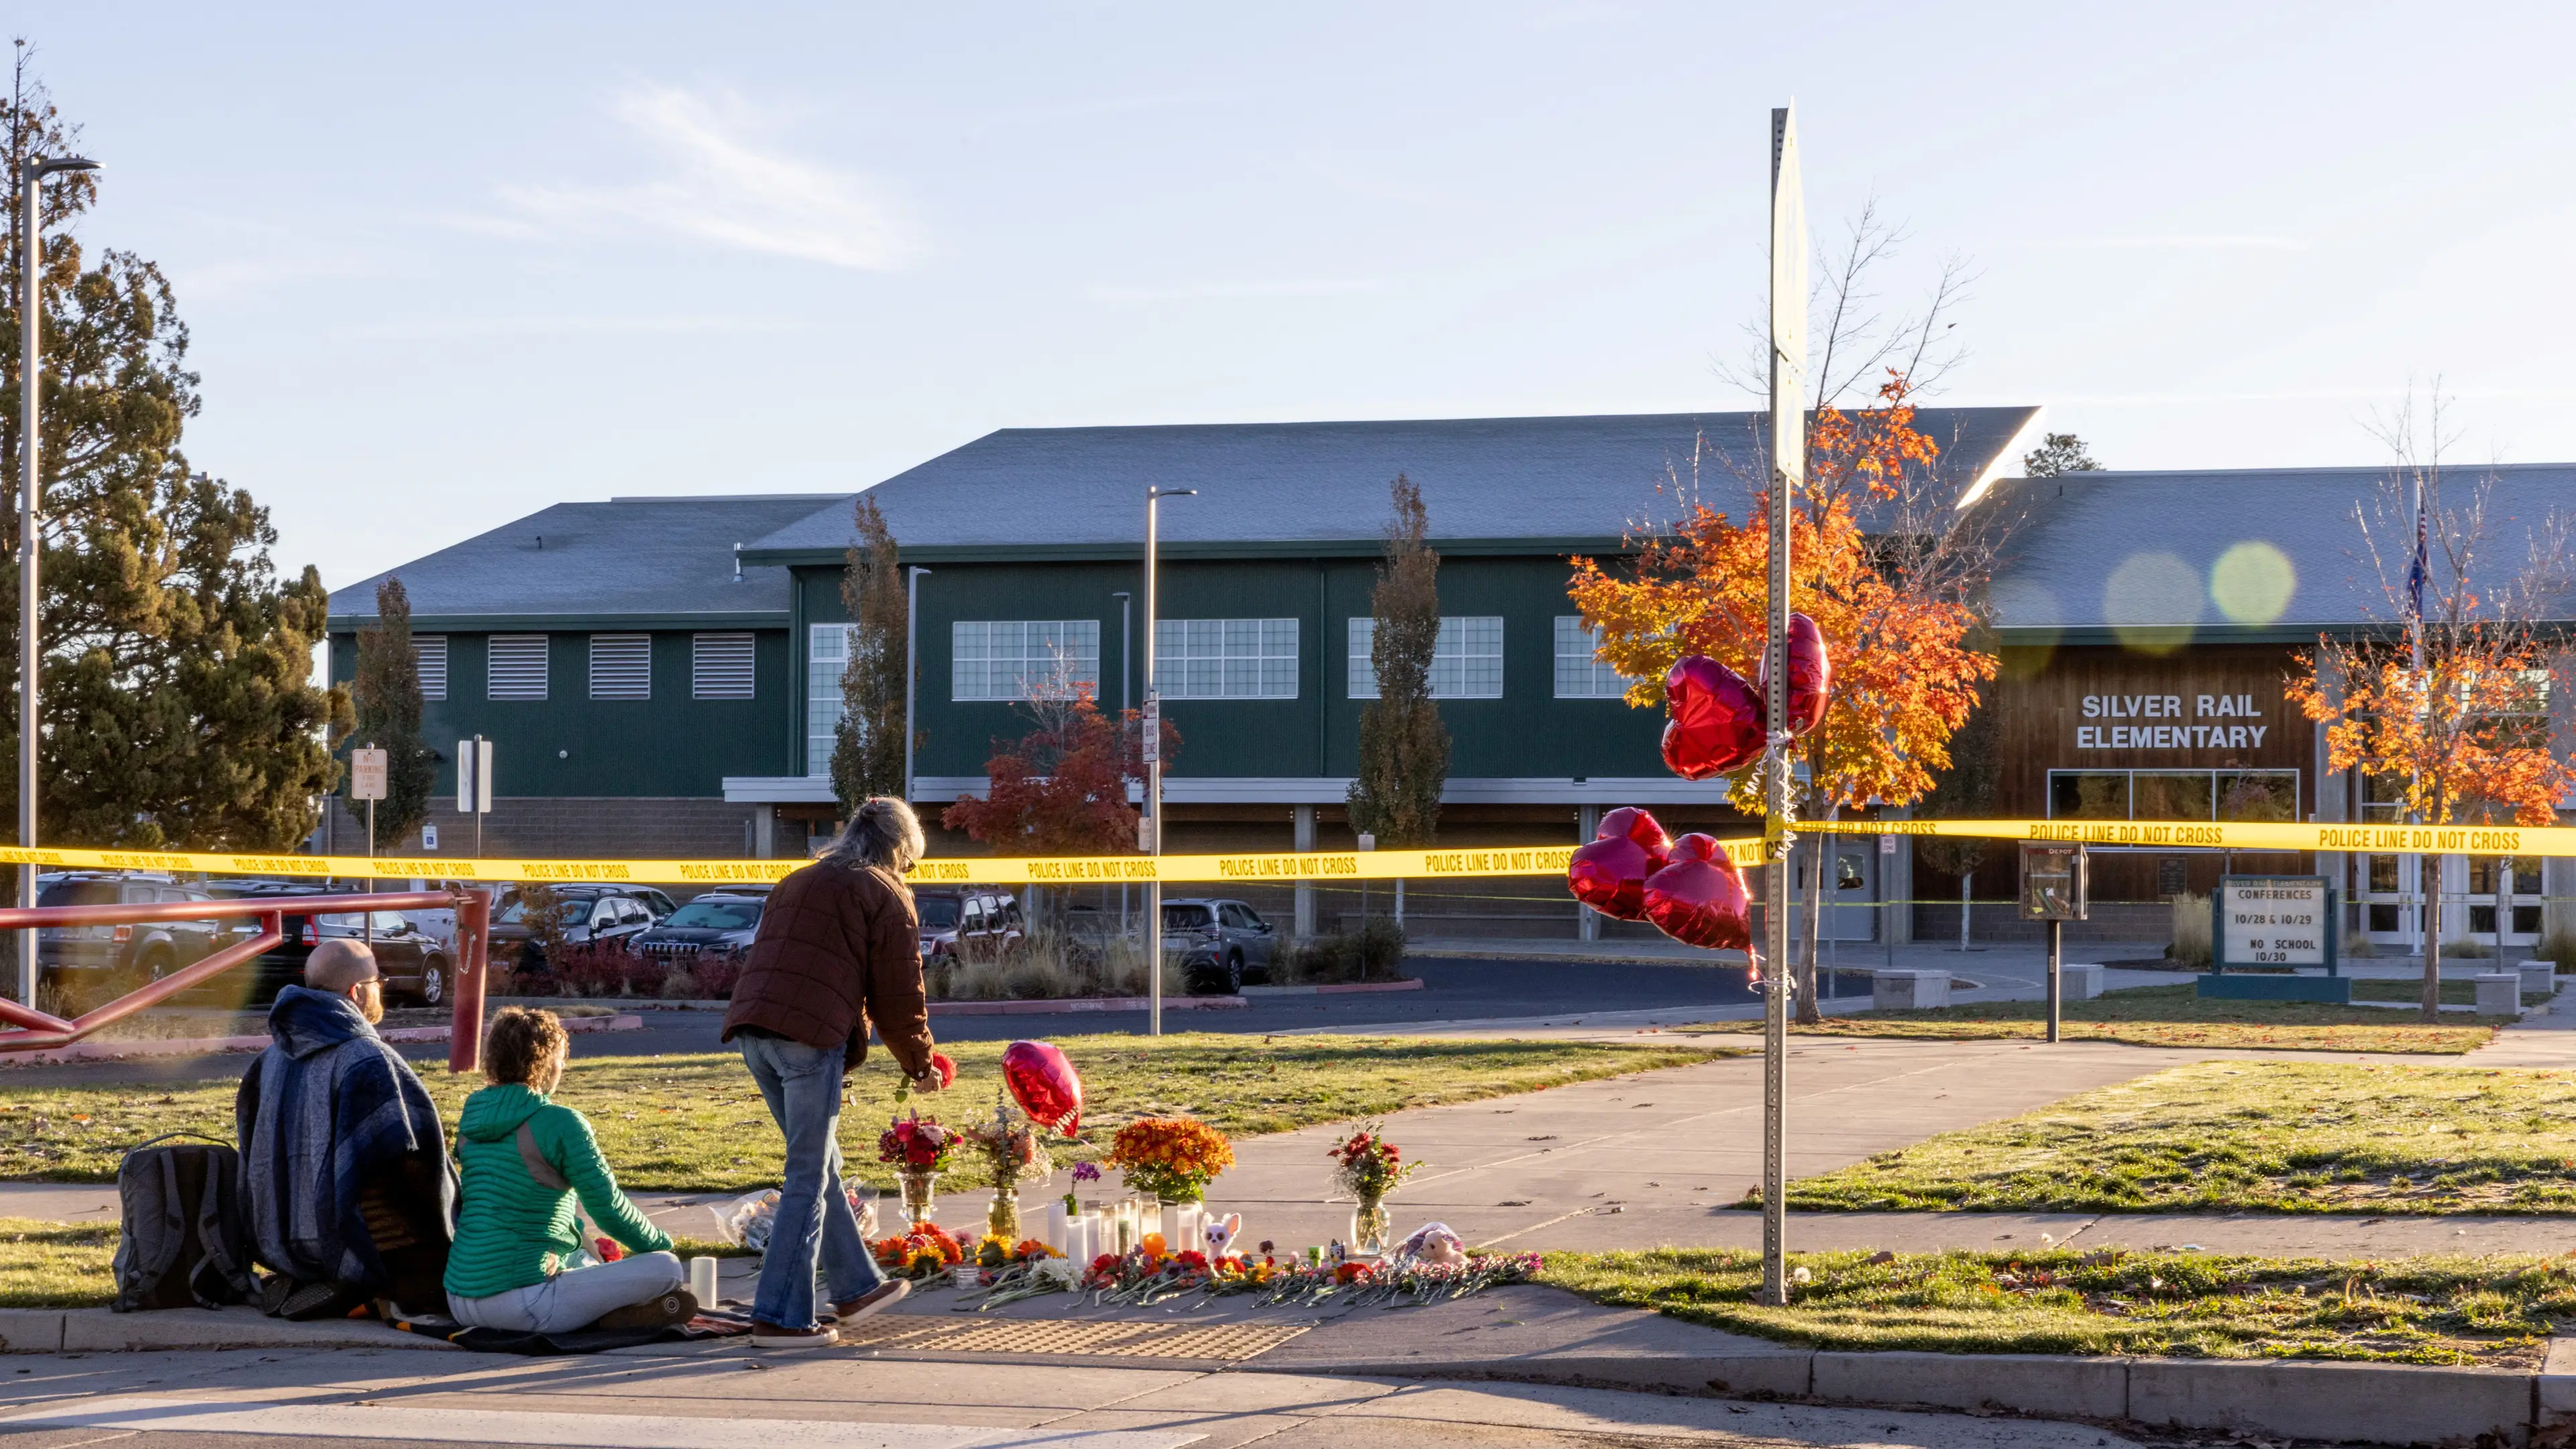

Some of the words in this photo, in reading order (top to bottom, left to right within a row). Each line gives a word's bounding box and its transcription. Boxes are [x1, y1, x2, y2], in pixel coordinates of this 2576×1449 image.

[2082, 695, 2182, 717] SILVER
[2197, 694, 2261, 716] RAIL
[2077, 726, 2267, 748] ELEMENTARY
[363, 755, 376, 763] NO
[355, 765, 384, 773] PARKING
[1861, 822, 1886, 833] NOT
[1892, 822, 1936, 834] CROSS
[2030, 824, 2079, 839] POLICE
[2084, 825, 2114, 841] LINE
[2120, 826, 2138, 841] DO
[2144, 826, 2171, 843] NOT
[2176, 827, 2222, 843] CROSS
[2319, 829, 2370, 847] POLICE
[2376, 830, 2407, 848] LINE
[2413, 830, 2432, 849] DO
[2438, 831, 2466, 849] NOT
[2471, 831, 2520, 850] CROSS
[1739, 843, 1762, 861] NOT
[233, 859, 261, 871] POLICE
[260, 859, 276, 871] LINE
[275, 859, 288, 871] DO
[288, 860, 303, 871] NOT
[303, 860, 330, 872] CROSS
[1220, 859, 1256, 876] POLICE
[1258, 859, 1281, 875] LINE
[1283, 858, 1297, 875] DO
[1300, 858, 1320, 875] NOT
[1323, 857, 1357, 874] CROSS
[1426, 855, 1463, 872] POLICE
[1466, 853, 1490, 871] LINE
[1493, 853, 1507, 871] DO
[1511, 852, 1532, 870] NOT
[1536, 851, 1570, 869] CROSS
[373, 862, 402, 874] POLICE
[401, 863, 420, 875] LINE
[418, 863, 431, 875] DO
[431, 863, 447, 876] NOT
[447, 863, 476, 876] CROSS
[522, 864, 551, 877] POLICE
[552, 864, 571, 877] LINE
[570, 865, 584, 877] DO
[584, 865, 601, 878] NOT
[602, 864, 629, 878] CROSS
[680, 865, 711, 879] POLICE
[711, 865, 731, 879] LINE
[731, 865, 745, 879] DO
[745, 865, 763, 879] NOT
[918, 864, 936, 879] NOT
[937, 863, 969, 879] CROSS
[1028, 863, 1061, 878] POLICE
[1063, 862, 1085, 878] LINE
[1086, 862, 1100, 877] DO
[1102, 862, 1121, 877] NOT
[1124, 861, 1157, 877] CROSS
[2238, 890, 2312, 899] CONFERENCES
[2235, 914, 2265, 924] 10/28
[2269, 915, 2275, 924] &
[2282, 915, 2312, 924] 10/29
[2251, 939, 2263, 949] NO
[2275, 940, 2315, 949] SCHOOL
[2256, 952, 2286, 961] 10/30
